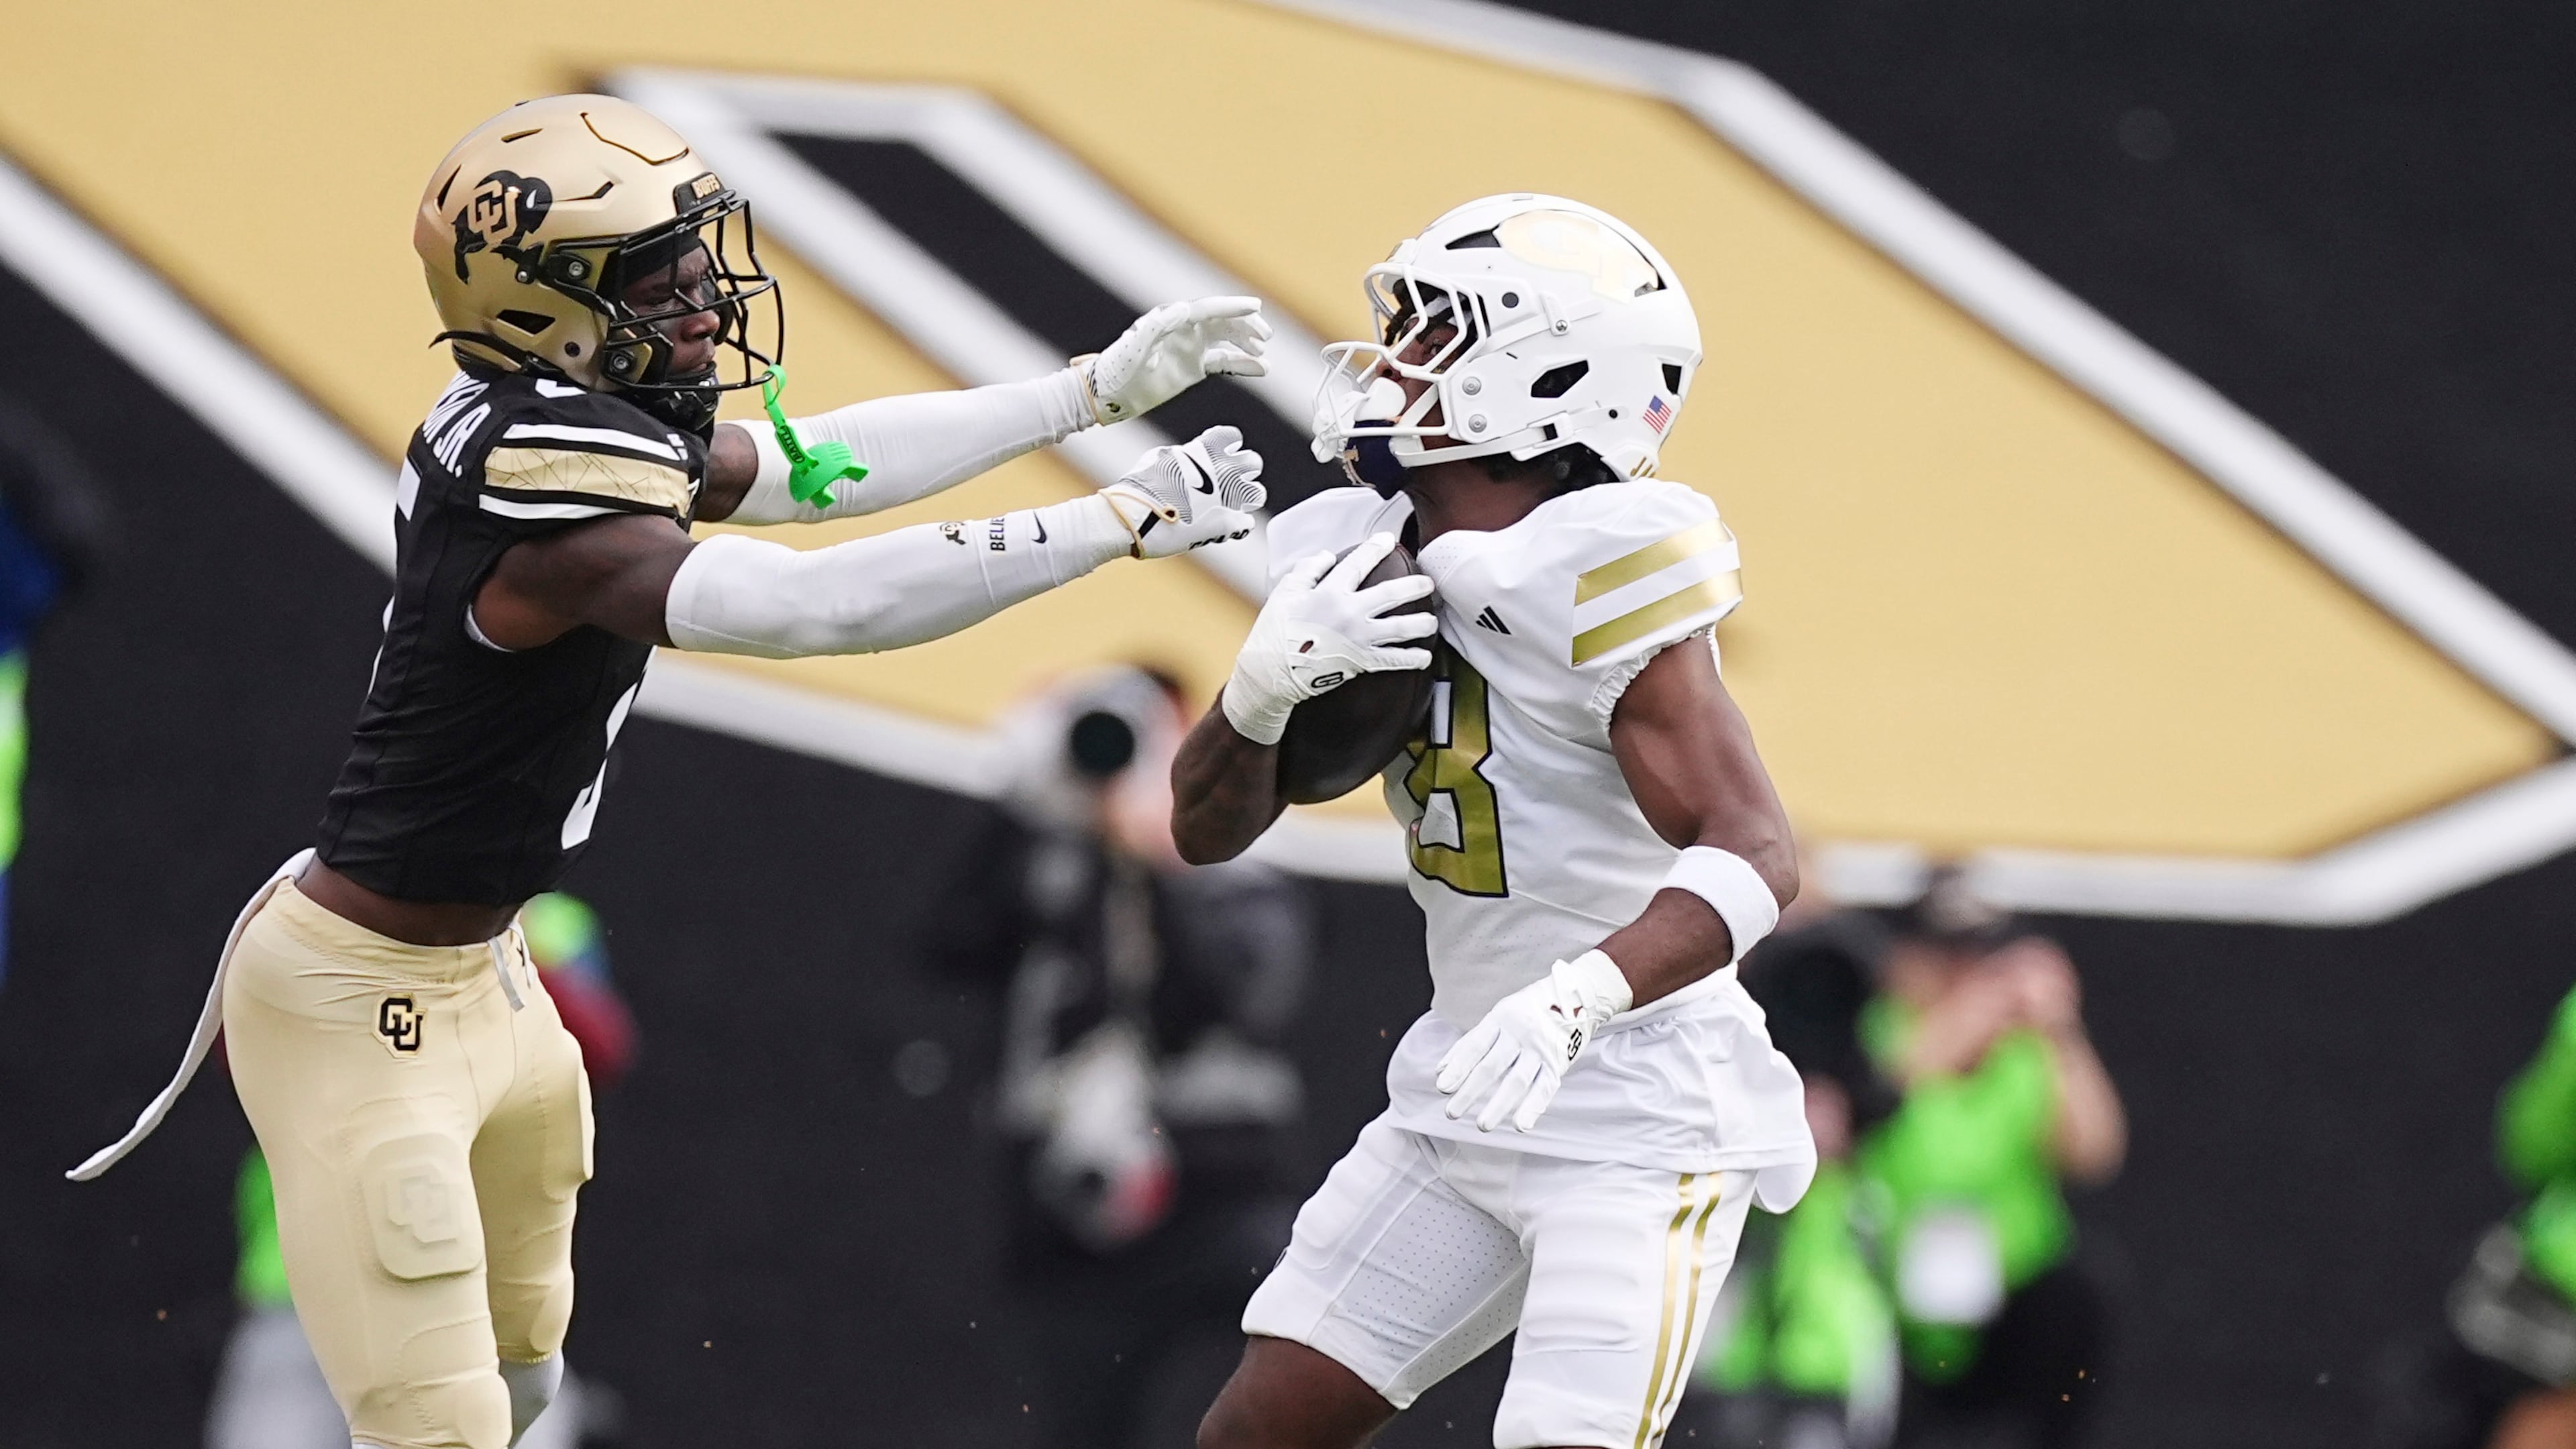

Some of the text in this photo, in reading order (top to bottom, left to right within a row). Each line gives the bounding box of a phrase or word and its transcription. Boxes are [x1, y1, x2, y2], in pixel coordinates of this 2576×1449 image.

[467, 179, 521, 246] CU
[433, 402, 492, 478] JR.
[1406, 637, 1509, 898] 8
[379, 998, 423, 1051] CU
